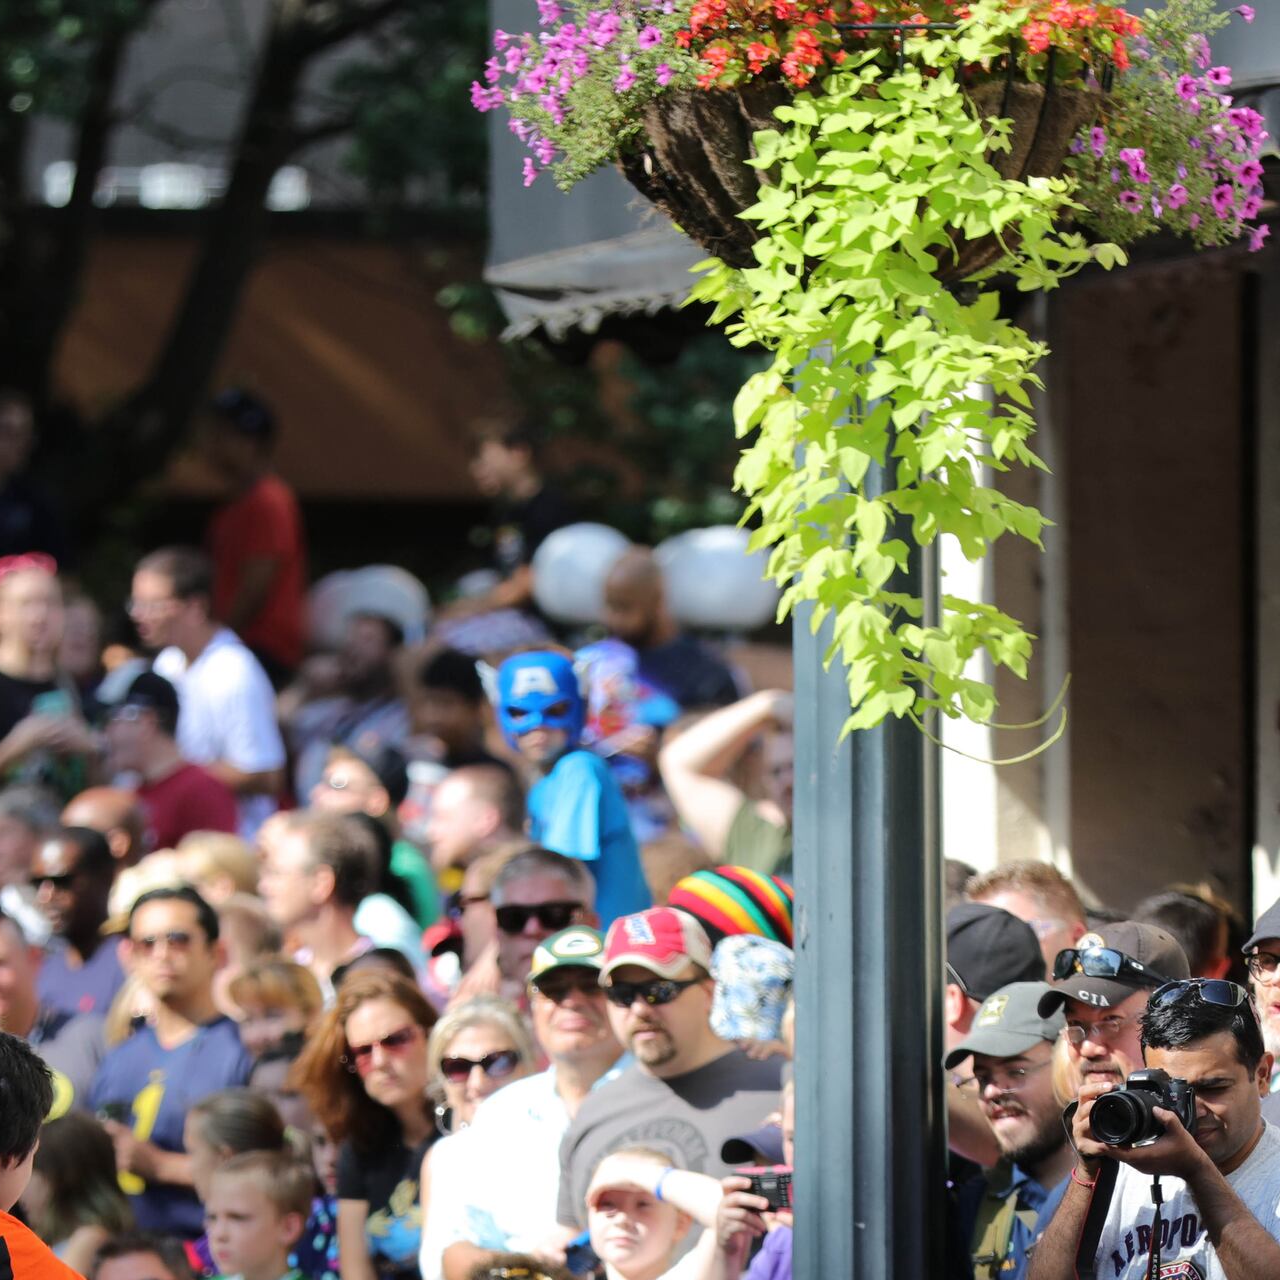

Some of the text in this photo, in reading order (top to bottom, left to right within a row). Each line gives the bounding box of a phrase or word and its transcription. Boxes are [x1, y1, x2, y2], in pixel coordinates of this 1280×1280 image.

[512, 666, 558, 697] A
[1078, 990, 1110, 1007] CIA
[1111, 1213, 1199, 1277] AEROPO
